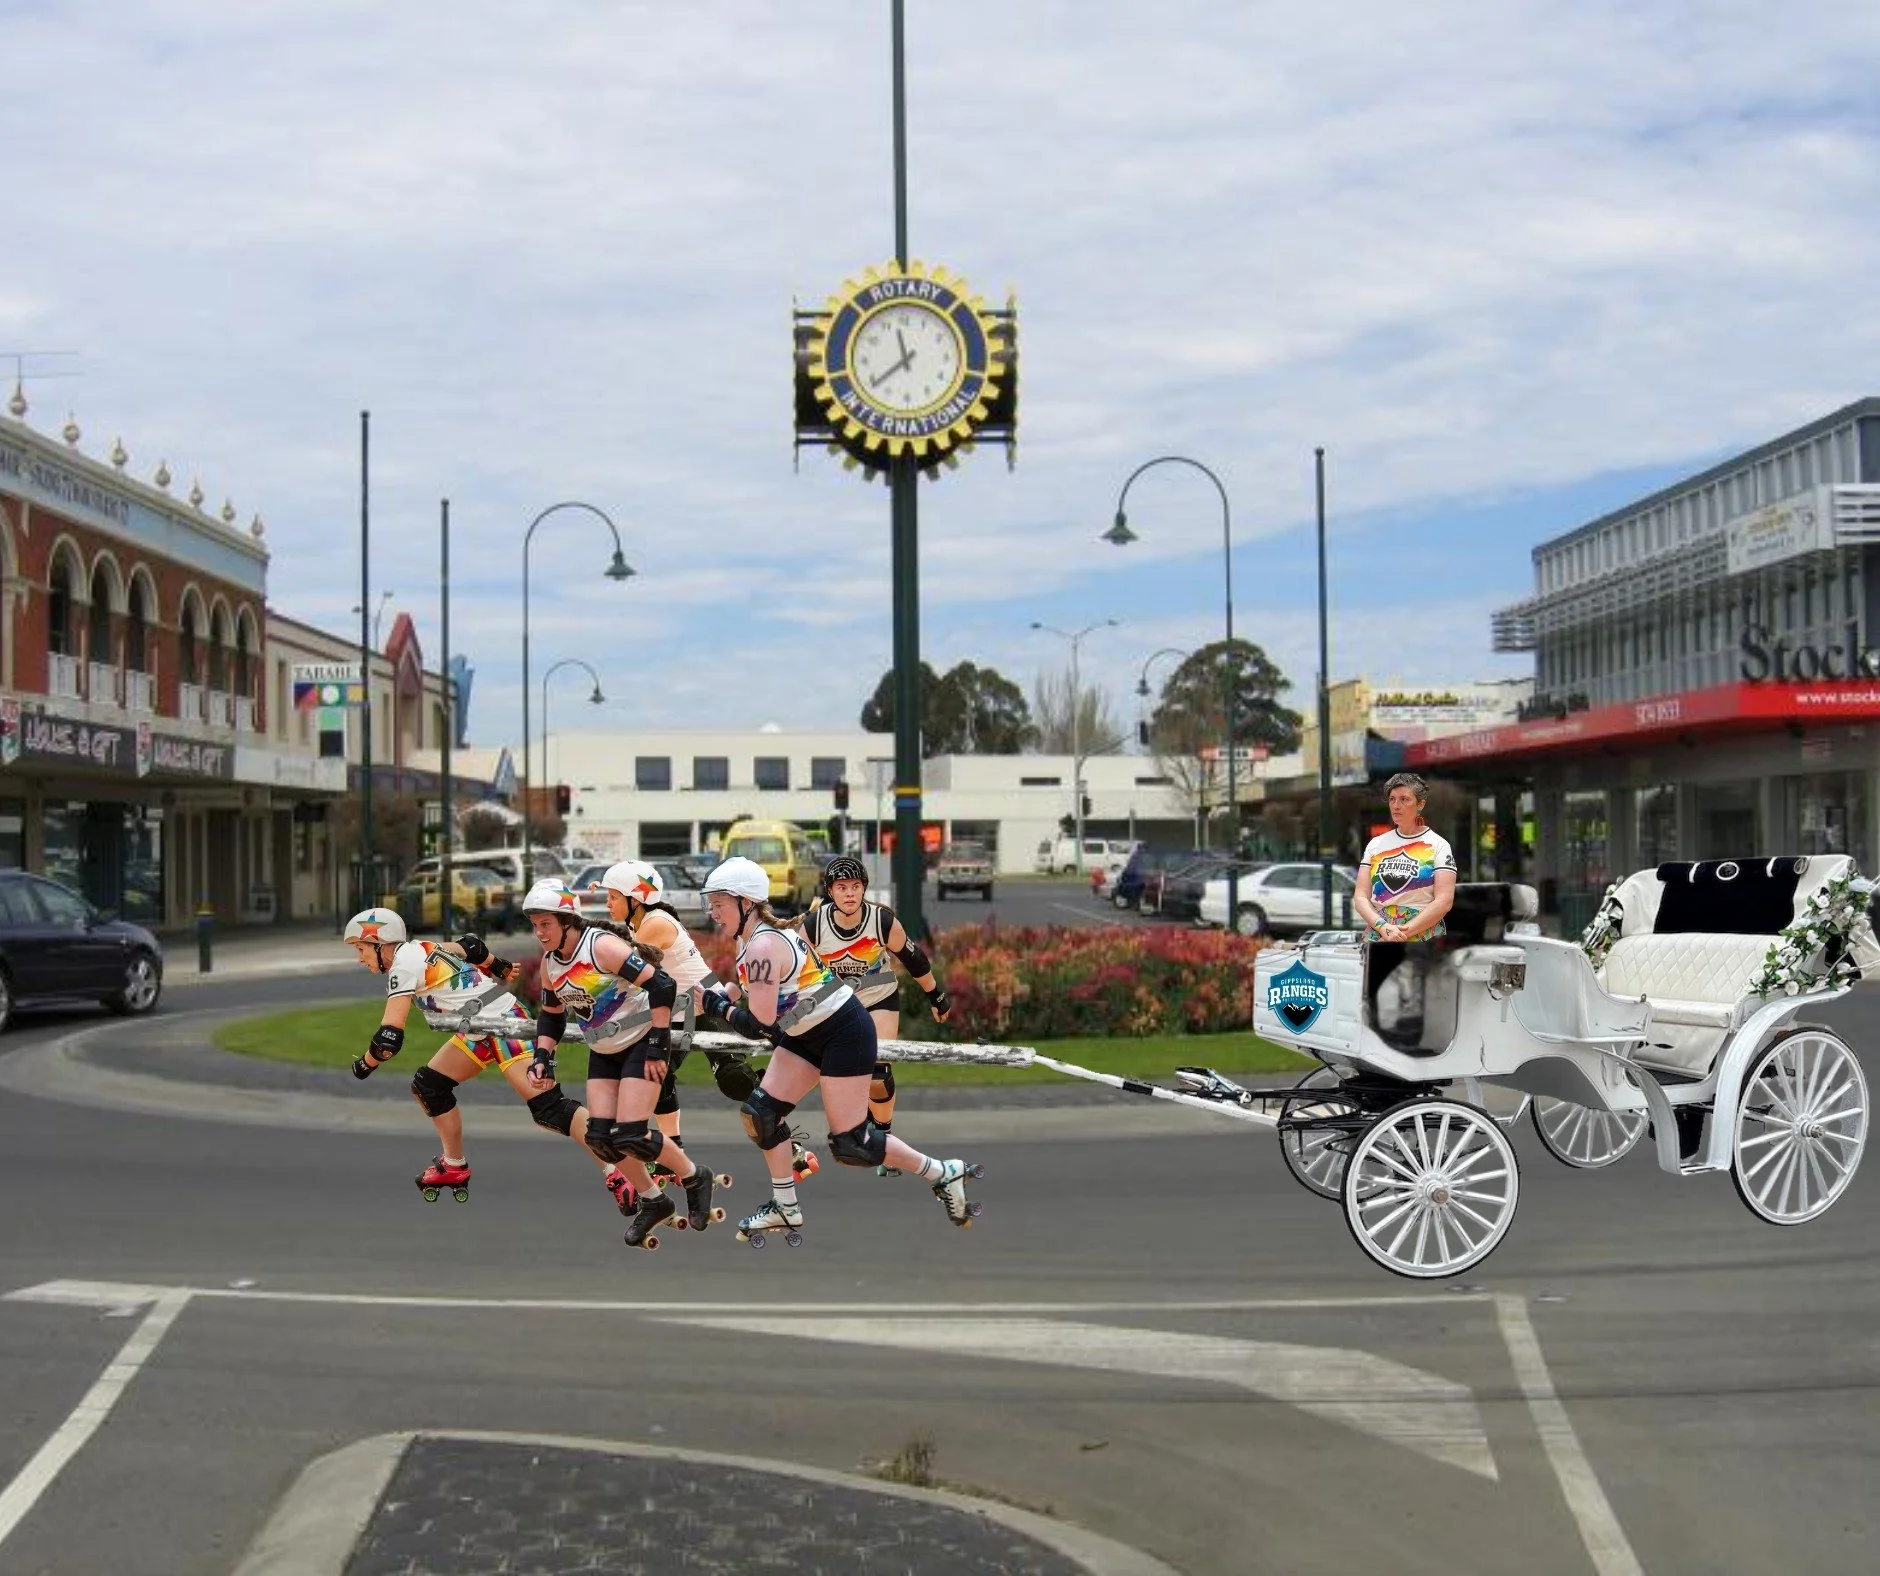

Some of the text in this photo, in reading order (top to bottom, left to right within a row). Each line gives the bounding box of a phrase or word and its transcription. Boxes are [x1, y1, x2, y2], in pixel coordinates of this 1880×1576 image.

[869, 281, 942, 302] ROTARY
[841, 390, 976, 434] INTERNATIONAL
[1377, 863, 1419, 877] RANGES
[1280, 977, 1316, 985] GIPPSLAND
[1269, 985, 1327, 1006] RANGES
